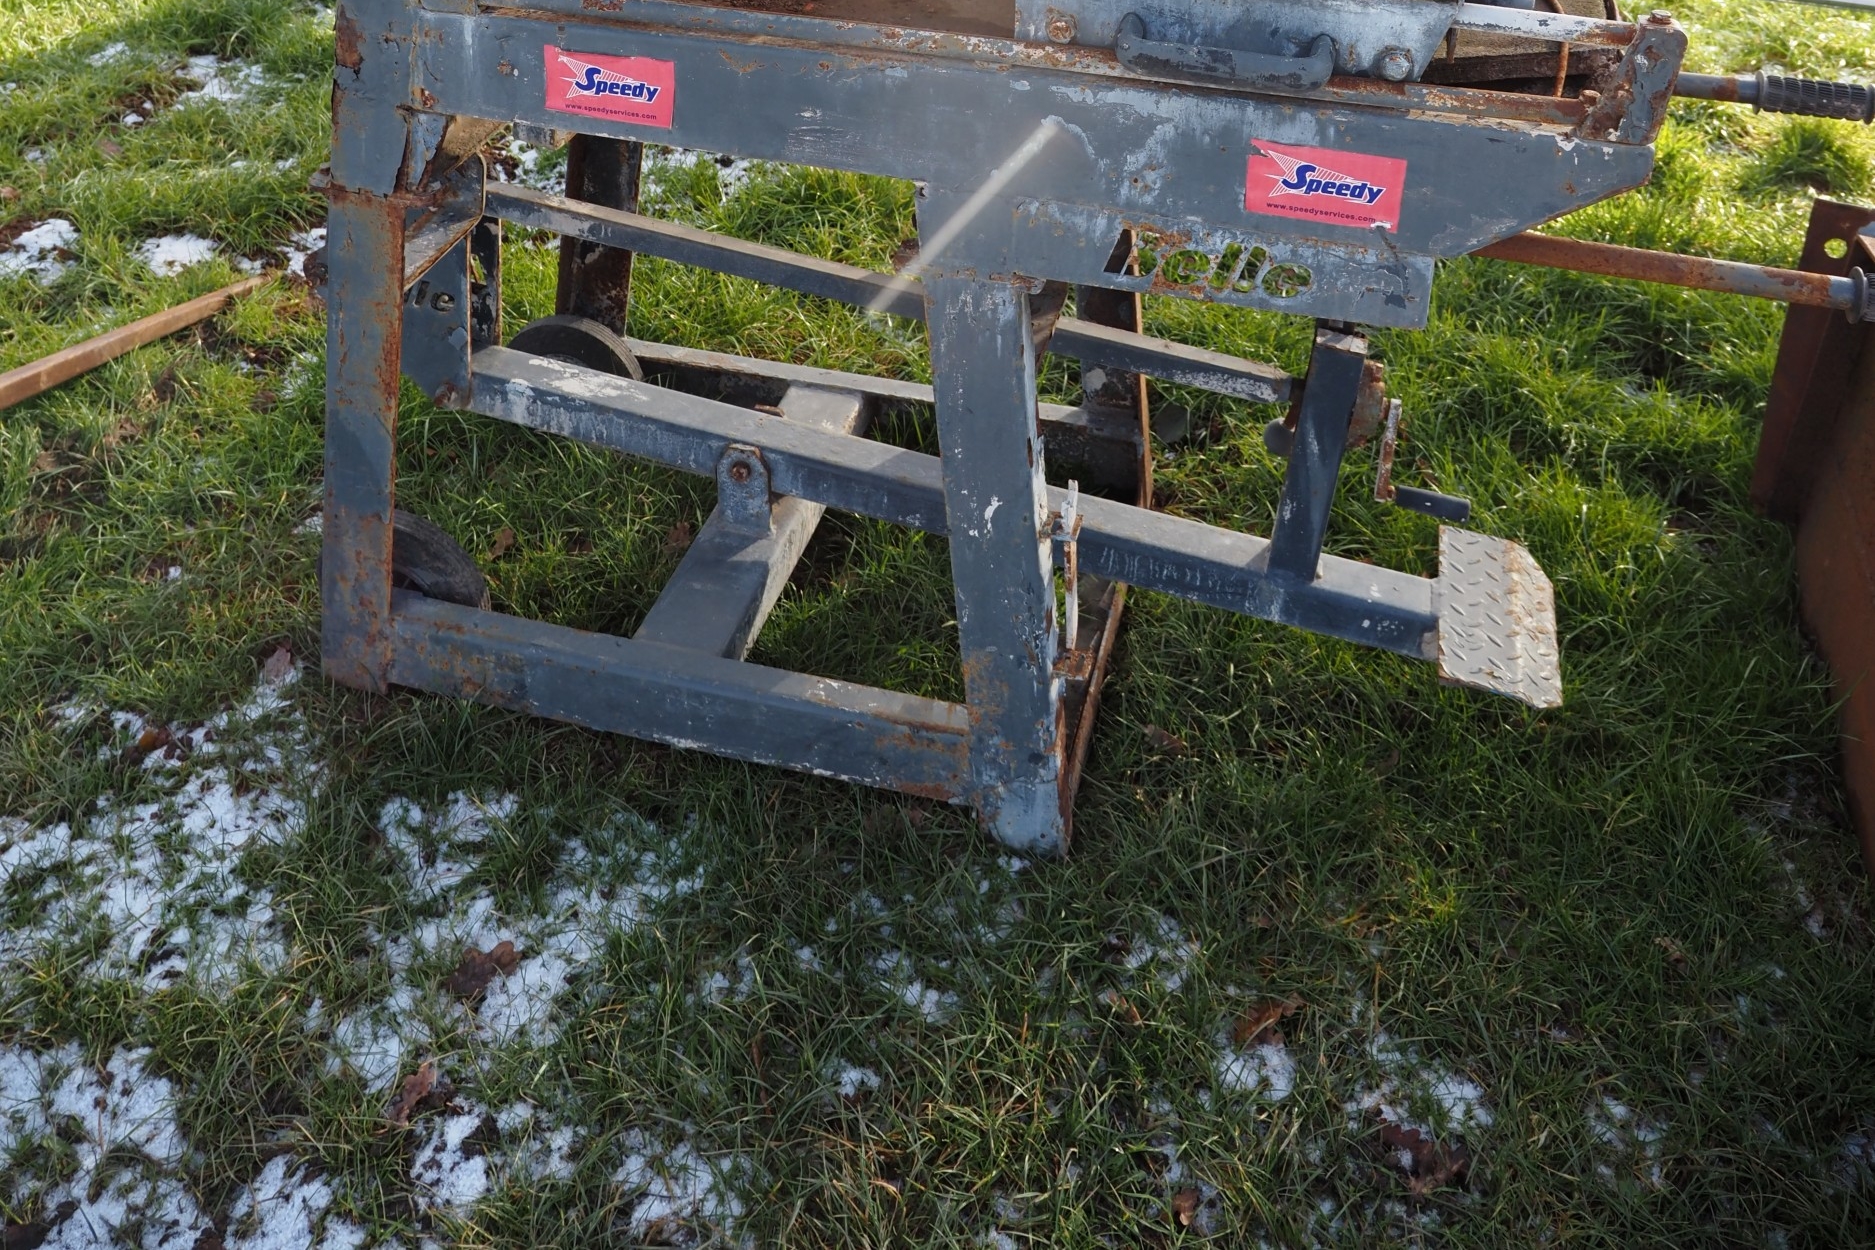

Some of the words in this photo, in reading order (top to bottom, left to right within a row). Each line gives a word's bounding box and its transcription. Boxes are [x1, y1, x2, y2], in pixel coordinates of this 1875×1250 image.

[575, 67, 660, 102] Speedy
[565, 103, 657, 120] www.speedyservices.com
[1281, 164, 1385, 204] Speedy
[1266, 202, 1376, 223] www.speedyservices.com
[1103, 227, 1312, 298] Belle
